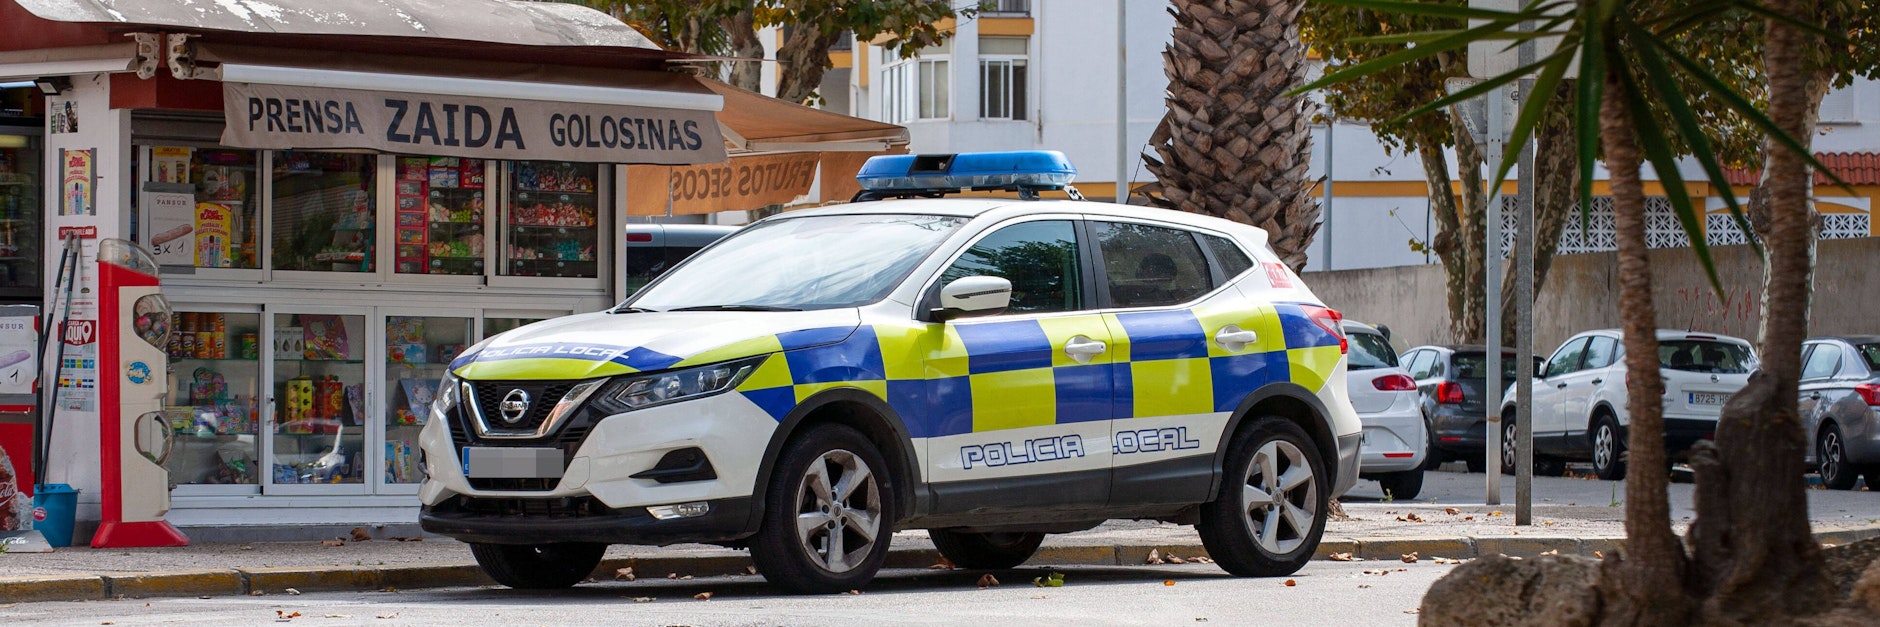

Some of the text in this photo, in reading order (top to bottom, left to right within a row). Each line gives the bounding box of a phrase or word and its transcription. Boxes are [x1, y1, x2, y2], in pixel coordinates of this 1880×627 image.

[248, 97, 703, 151] PRENSA ZAIDA GOLOSINAS
[470, 346, 630, 361] POLICIA LOCAL
[961, 427, 1200, 470] POLICIA OCAL
